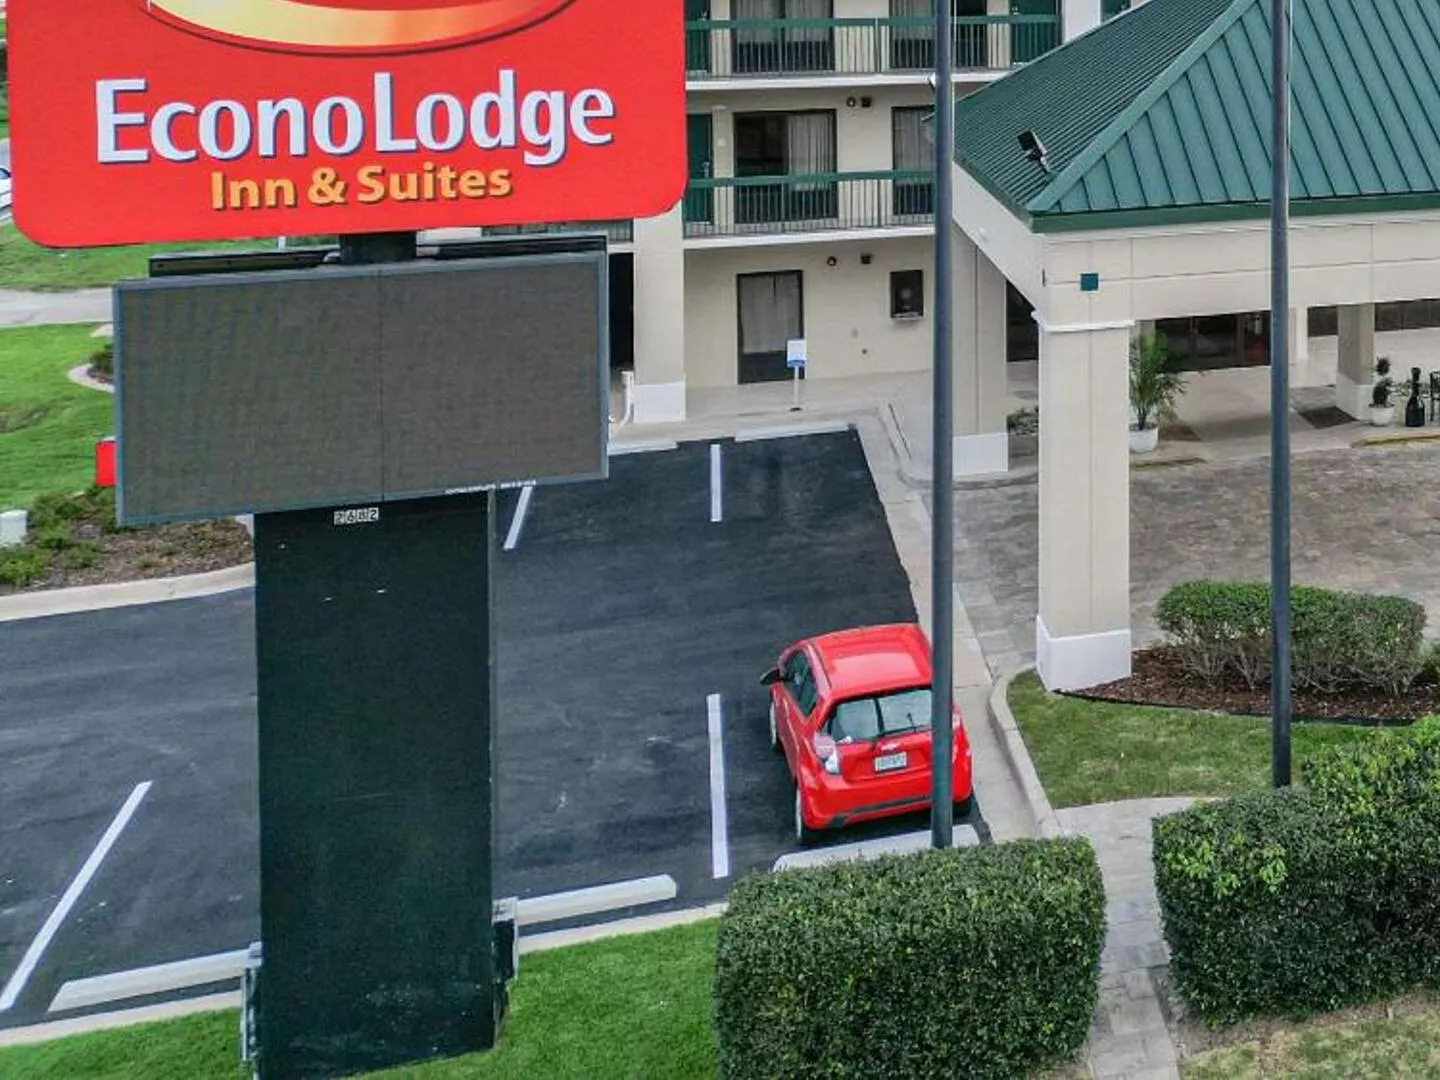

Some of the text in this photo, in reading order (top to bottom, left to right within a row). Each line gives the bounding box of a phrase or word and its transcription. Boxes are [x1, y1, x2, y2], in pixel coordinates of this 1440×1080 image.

[95, 69, 614, 166] EconoLodge
[211, 161, 512, 209] Inn & Suites
